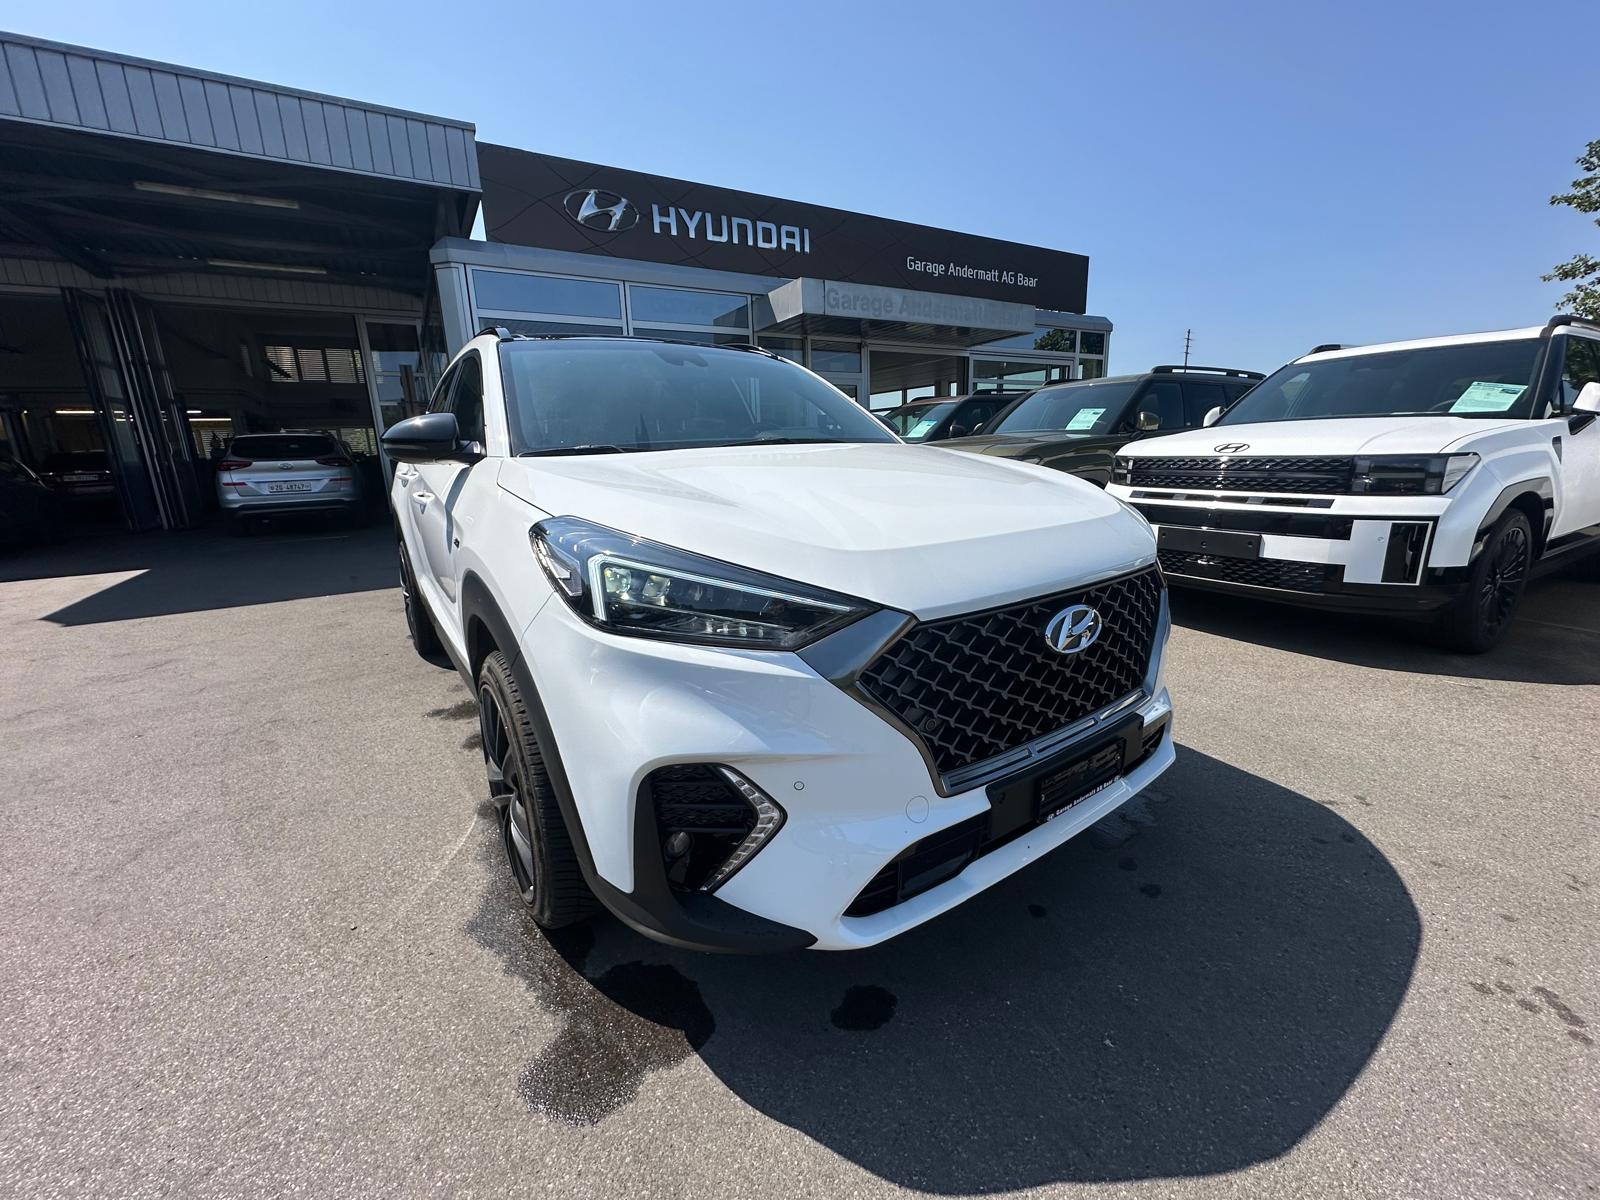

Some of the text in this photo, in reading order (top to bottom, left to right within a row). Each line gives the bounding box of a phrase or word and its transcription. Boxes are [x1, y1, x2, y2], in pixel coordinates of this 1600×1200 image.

[651, 203, 810, 255] HYUNDAI
[906, 256, 1039, 288] Garage Andermatt AG Baar
[826, 287, 893, 318] Garage
